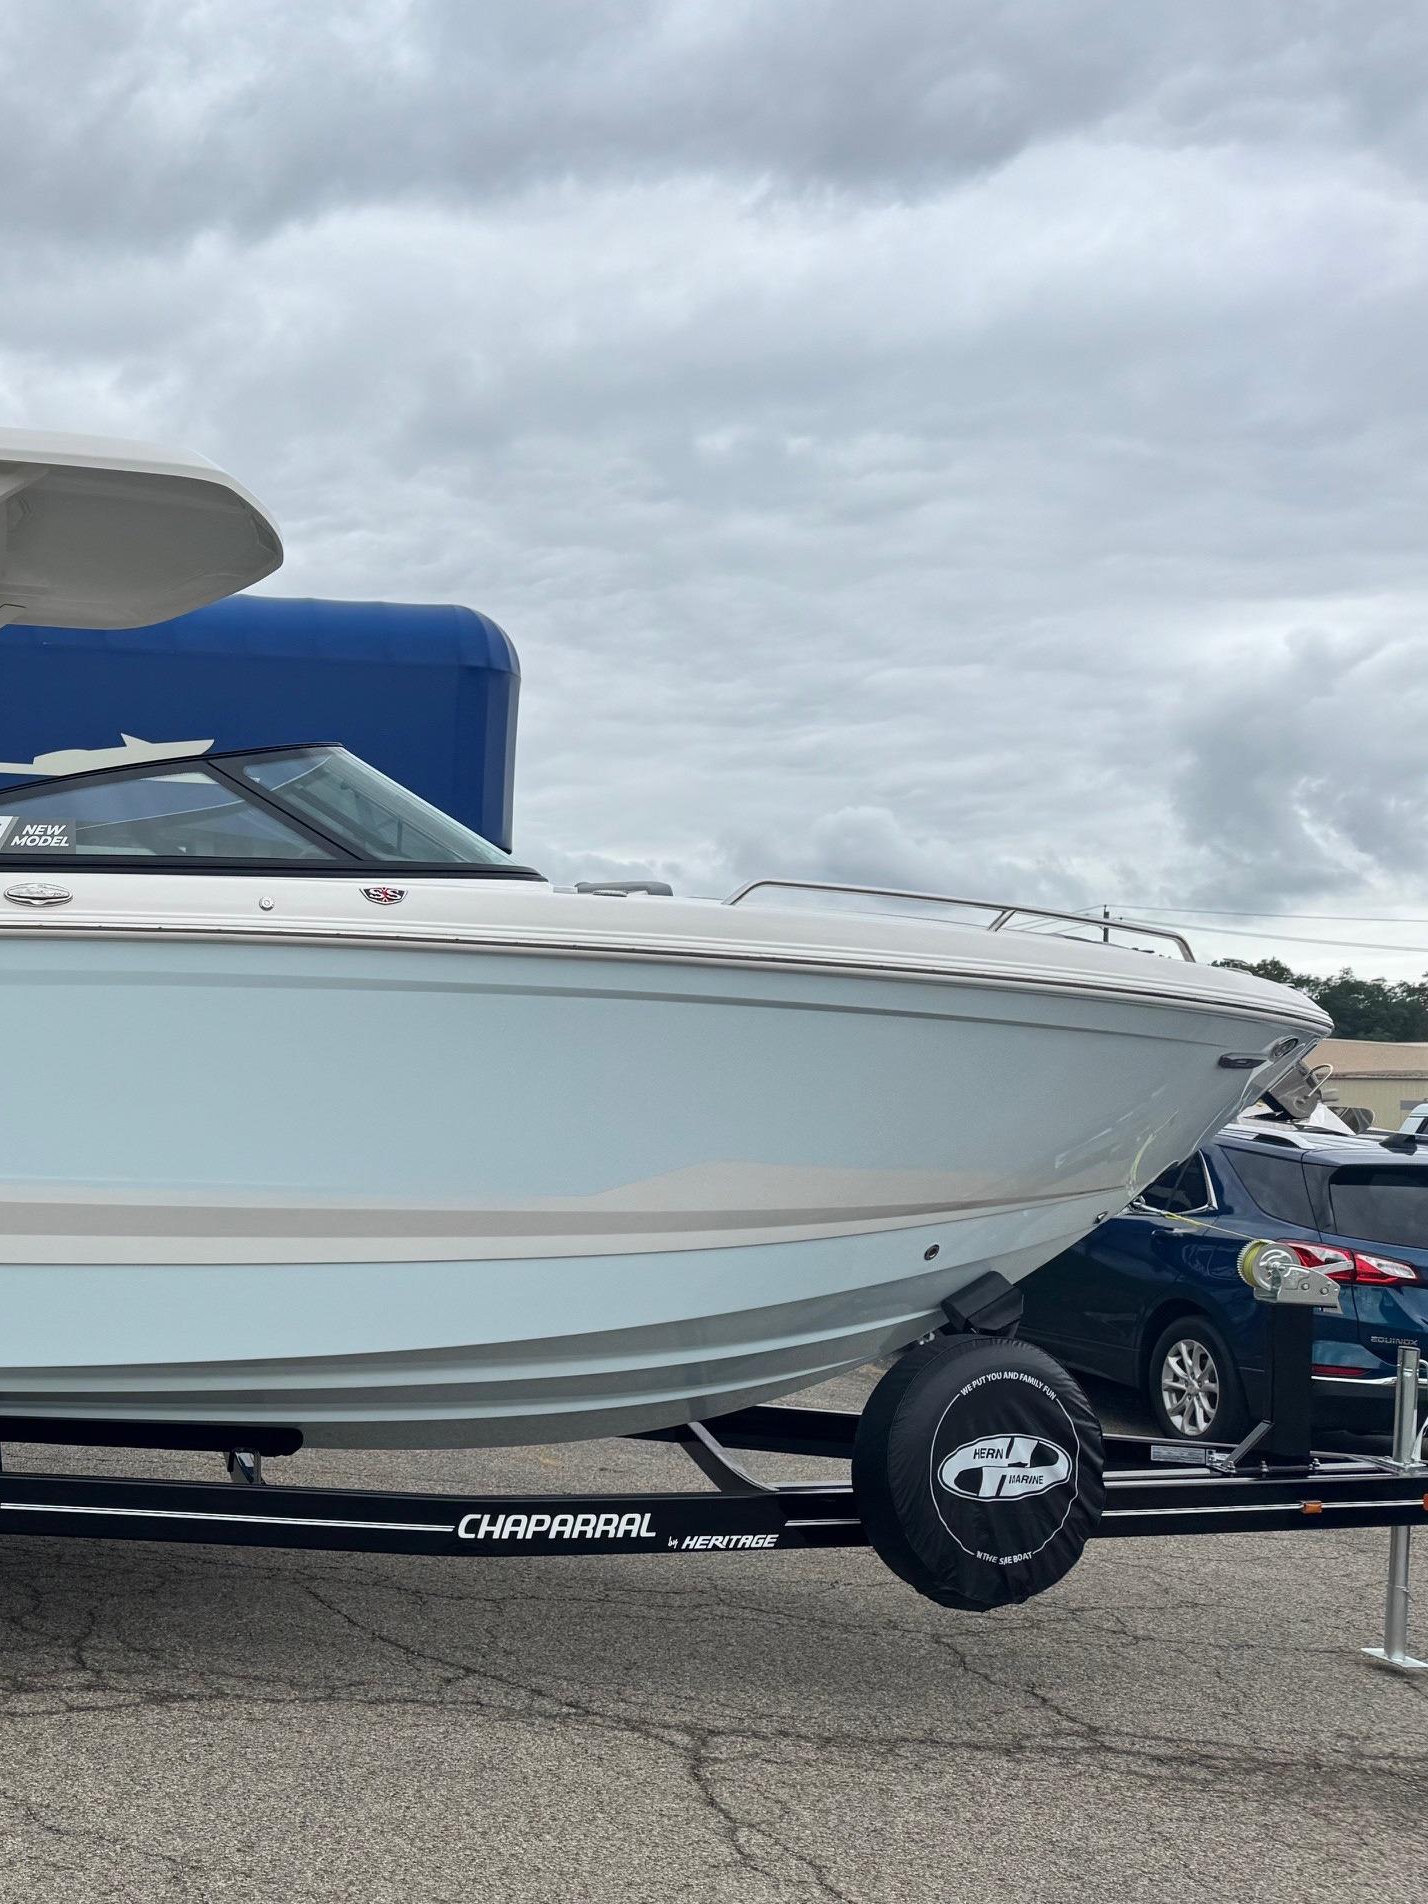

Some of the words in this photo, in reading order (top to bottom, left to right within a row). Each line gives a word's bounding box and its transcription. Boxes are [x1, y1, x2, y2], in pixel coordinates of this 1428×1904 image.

[22, 824, 67, 835] NEW
[11, 836, 70, 847] MODEL
[1370, 1336, 1419, 1346] EQUINOX
[960, 1384, 973, 1396] WE
[972, 1376, 987, 1389] PUT
[986, 1371, 1002, 1382] YOU
[1003, 1371, 1019, 1380] AND
[1019, 1373, 1044, 1389] FAMILY
[1042, 1385, 1057, 1400] FUN
[973, 1448, 1004, 1459] HERN
[1008, 1474, 1044, 1485] MARINE
[458, 1513, 657, 1539] CHAPARRAL
[668, 1535, 678, 1549] by
[681, 1534, 779, 1549] HERITAGE
[983, 1552, 998, 1563] THE
[1013, 1551, 1032, 1563] BOAT
